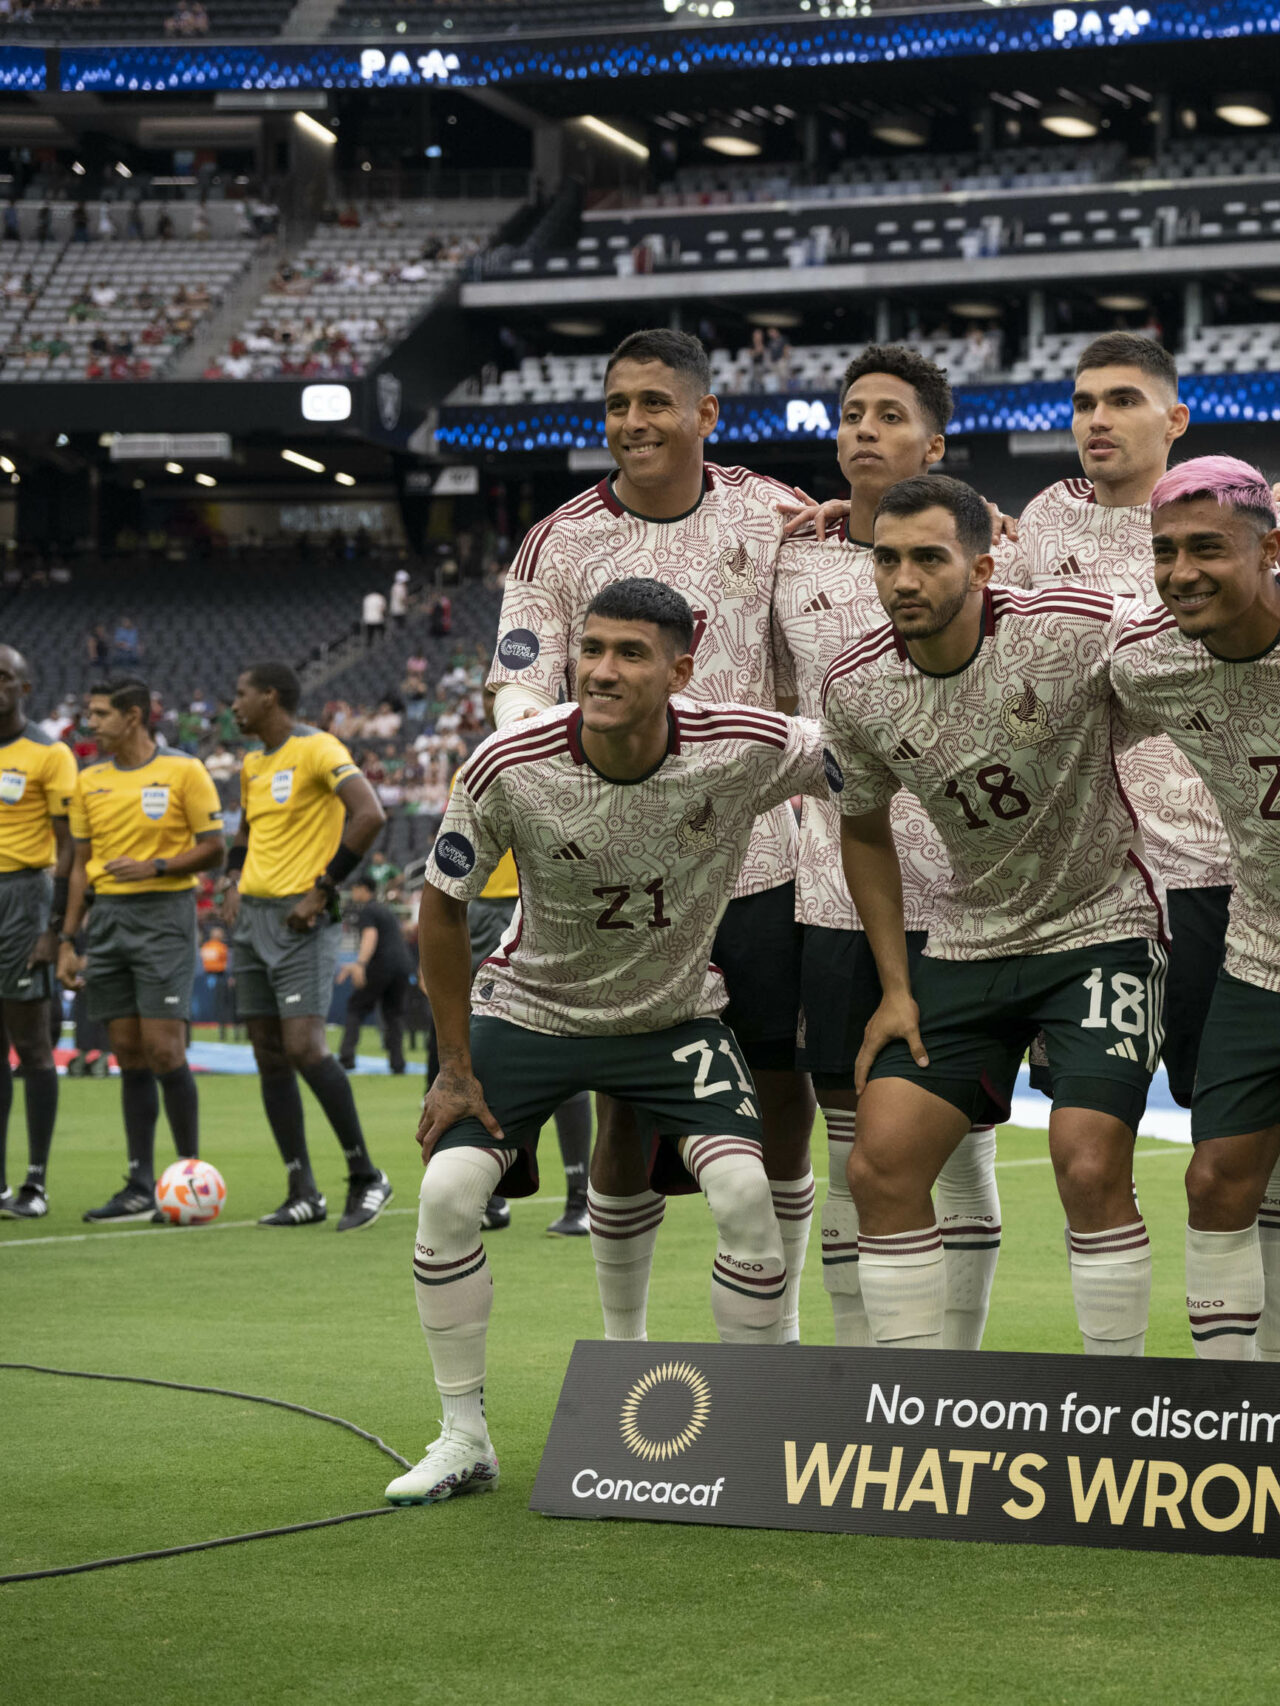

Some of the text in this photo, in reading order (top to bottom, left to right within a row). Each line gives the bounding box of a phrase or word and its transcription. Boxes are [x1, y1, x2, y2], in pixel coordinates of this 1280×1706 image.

[944, 763, 1032, 829] 18
[592, 877, 672, 930] 21
[1081, 967, 1146, 1036] 18
[672, 1038, 755, 1099] 21
[719, 1253, 764, 1272] MÉXICO
[866, 1384, 924, 1426] No
[935, 1399, 1047, 1431] room
[1061, 1392, 1121, 1434] for
[572, 1468, 725, 1506] Concacaf
[784, 1441, 1048, 1520] WHAT'S
